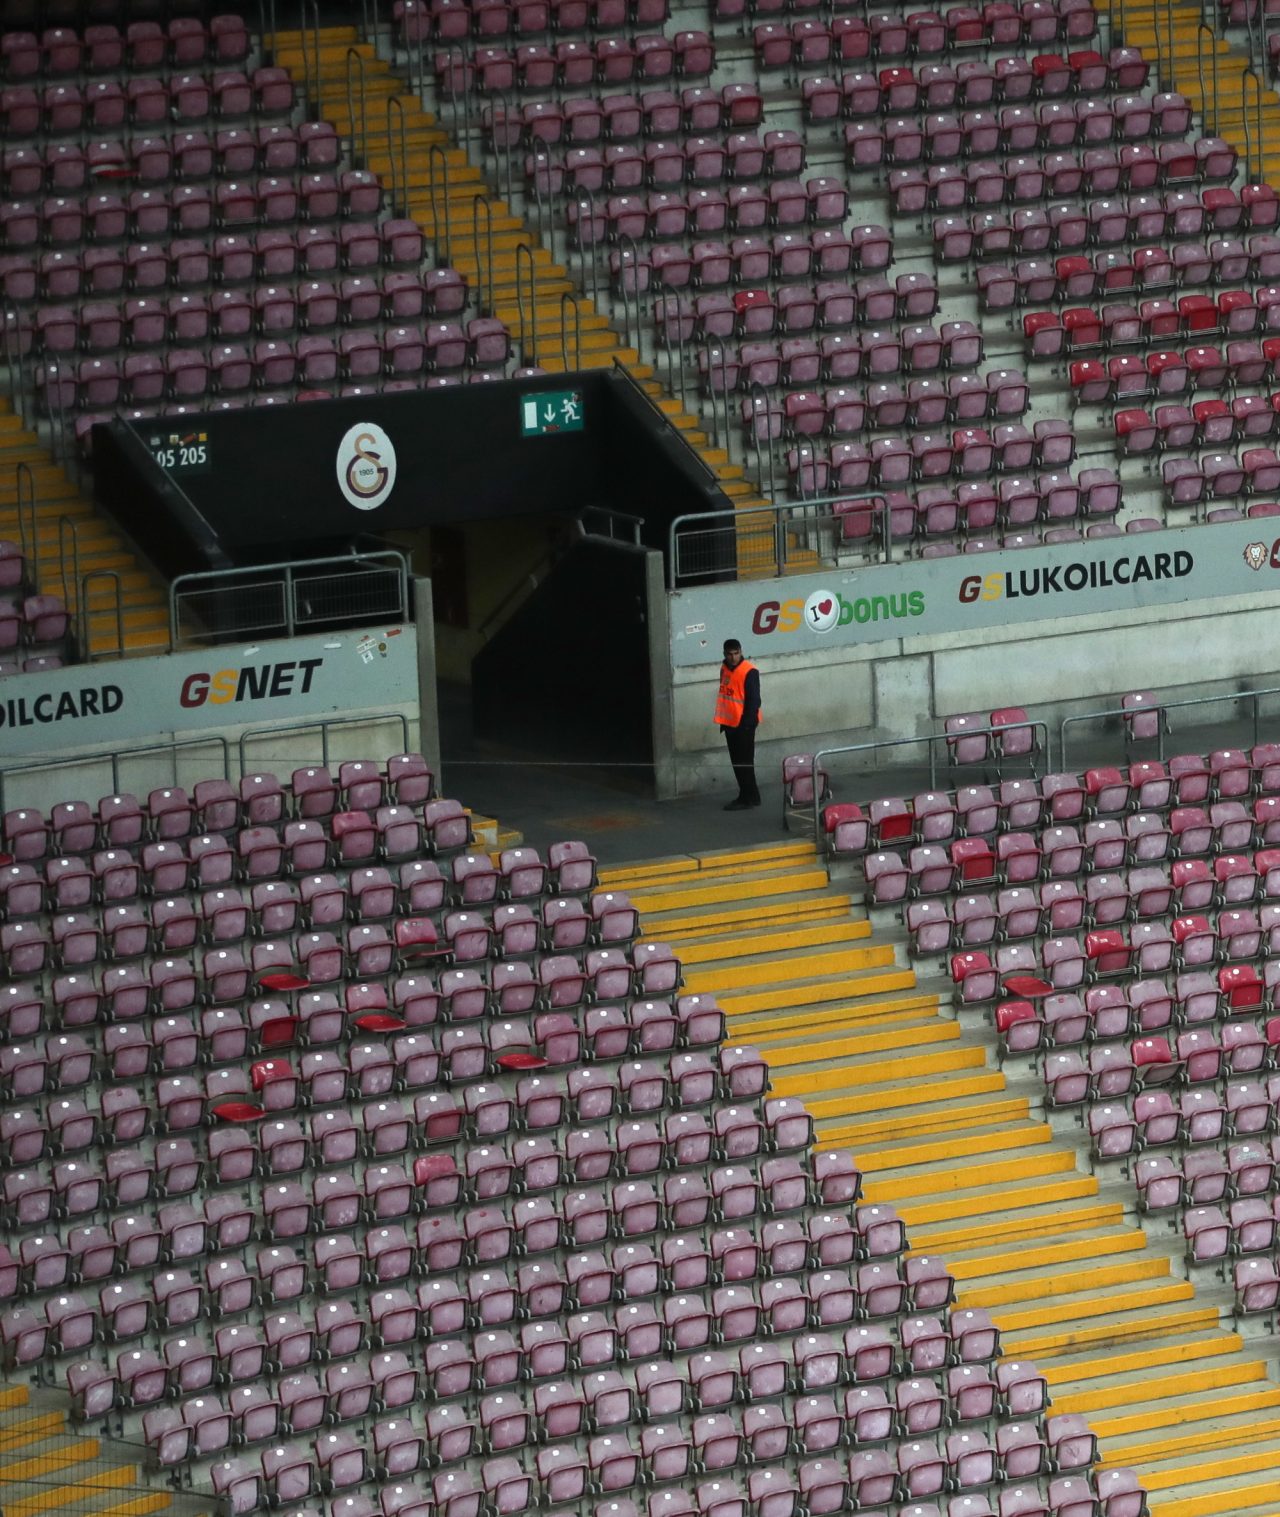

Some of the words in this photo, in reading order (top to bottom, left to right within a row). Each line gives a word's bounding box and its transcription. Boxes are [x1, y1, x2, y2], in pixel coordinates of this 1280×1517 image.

[152, 449, 176, 468] 05
[179, 446, 207, 466] 205
[751, 597, 806, 636] GS
[836, 590, 926, 627] bonus
[179, 657, 323, 708] GSNET
[0, 684, 124, 729] ILCARD
